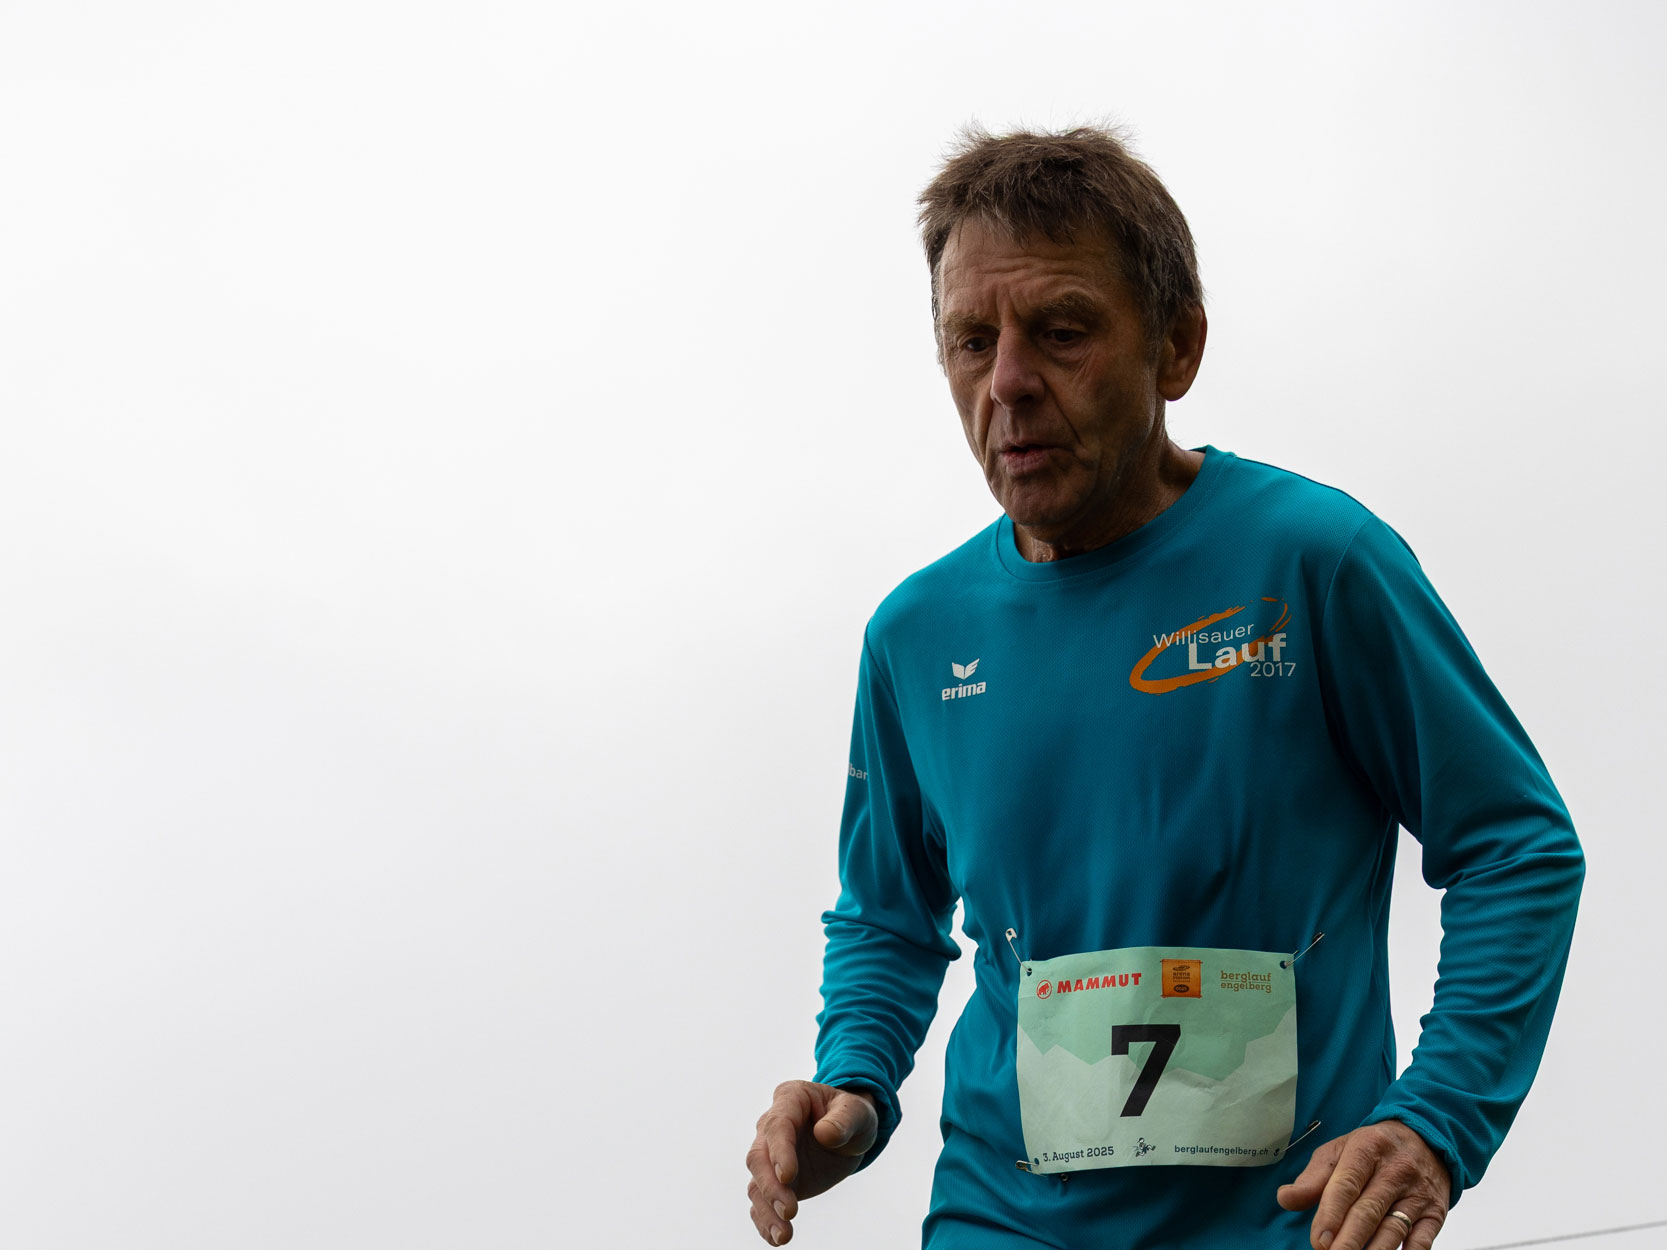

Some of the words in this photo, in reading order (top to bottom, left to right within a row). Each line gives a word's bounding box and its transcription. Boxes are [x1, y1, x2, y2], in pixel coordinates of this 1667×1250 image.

[1153, 623, 1254, 649] Willisauer
[1188, 632, 1287, 670] Lauf
[1250, 661, 1297, 677] 2017
[941, 681, 987, 701] erima
[1057, 972, 1142, 994] MAMMUT
[1220, 970, 1272, 983] berglauf
[1220, 981, 1272, 994] engelberg
[1111, 1023, 1181, 1118] 7
[1042, 1152, 1051, 1162] 3.
[1052, 1151, 1085, 1163] August
[1086, 1146, 1114, 1158] 2025
[1174, 1145, 1269, 1157] berglaufengelberg.ch
